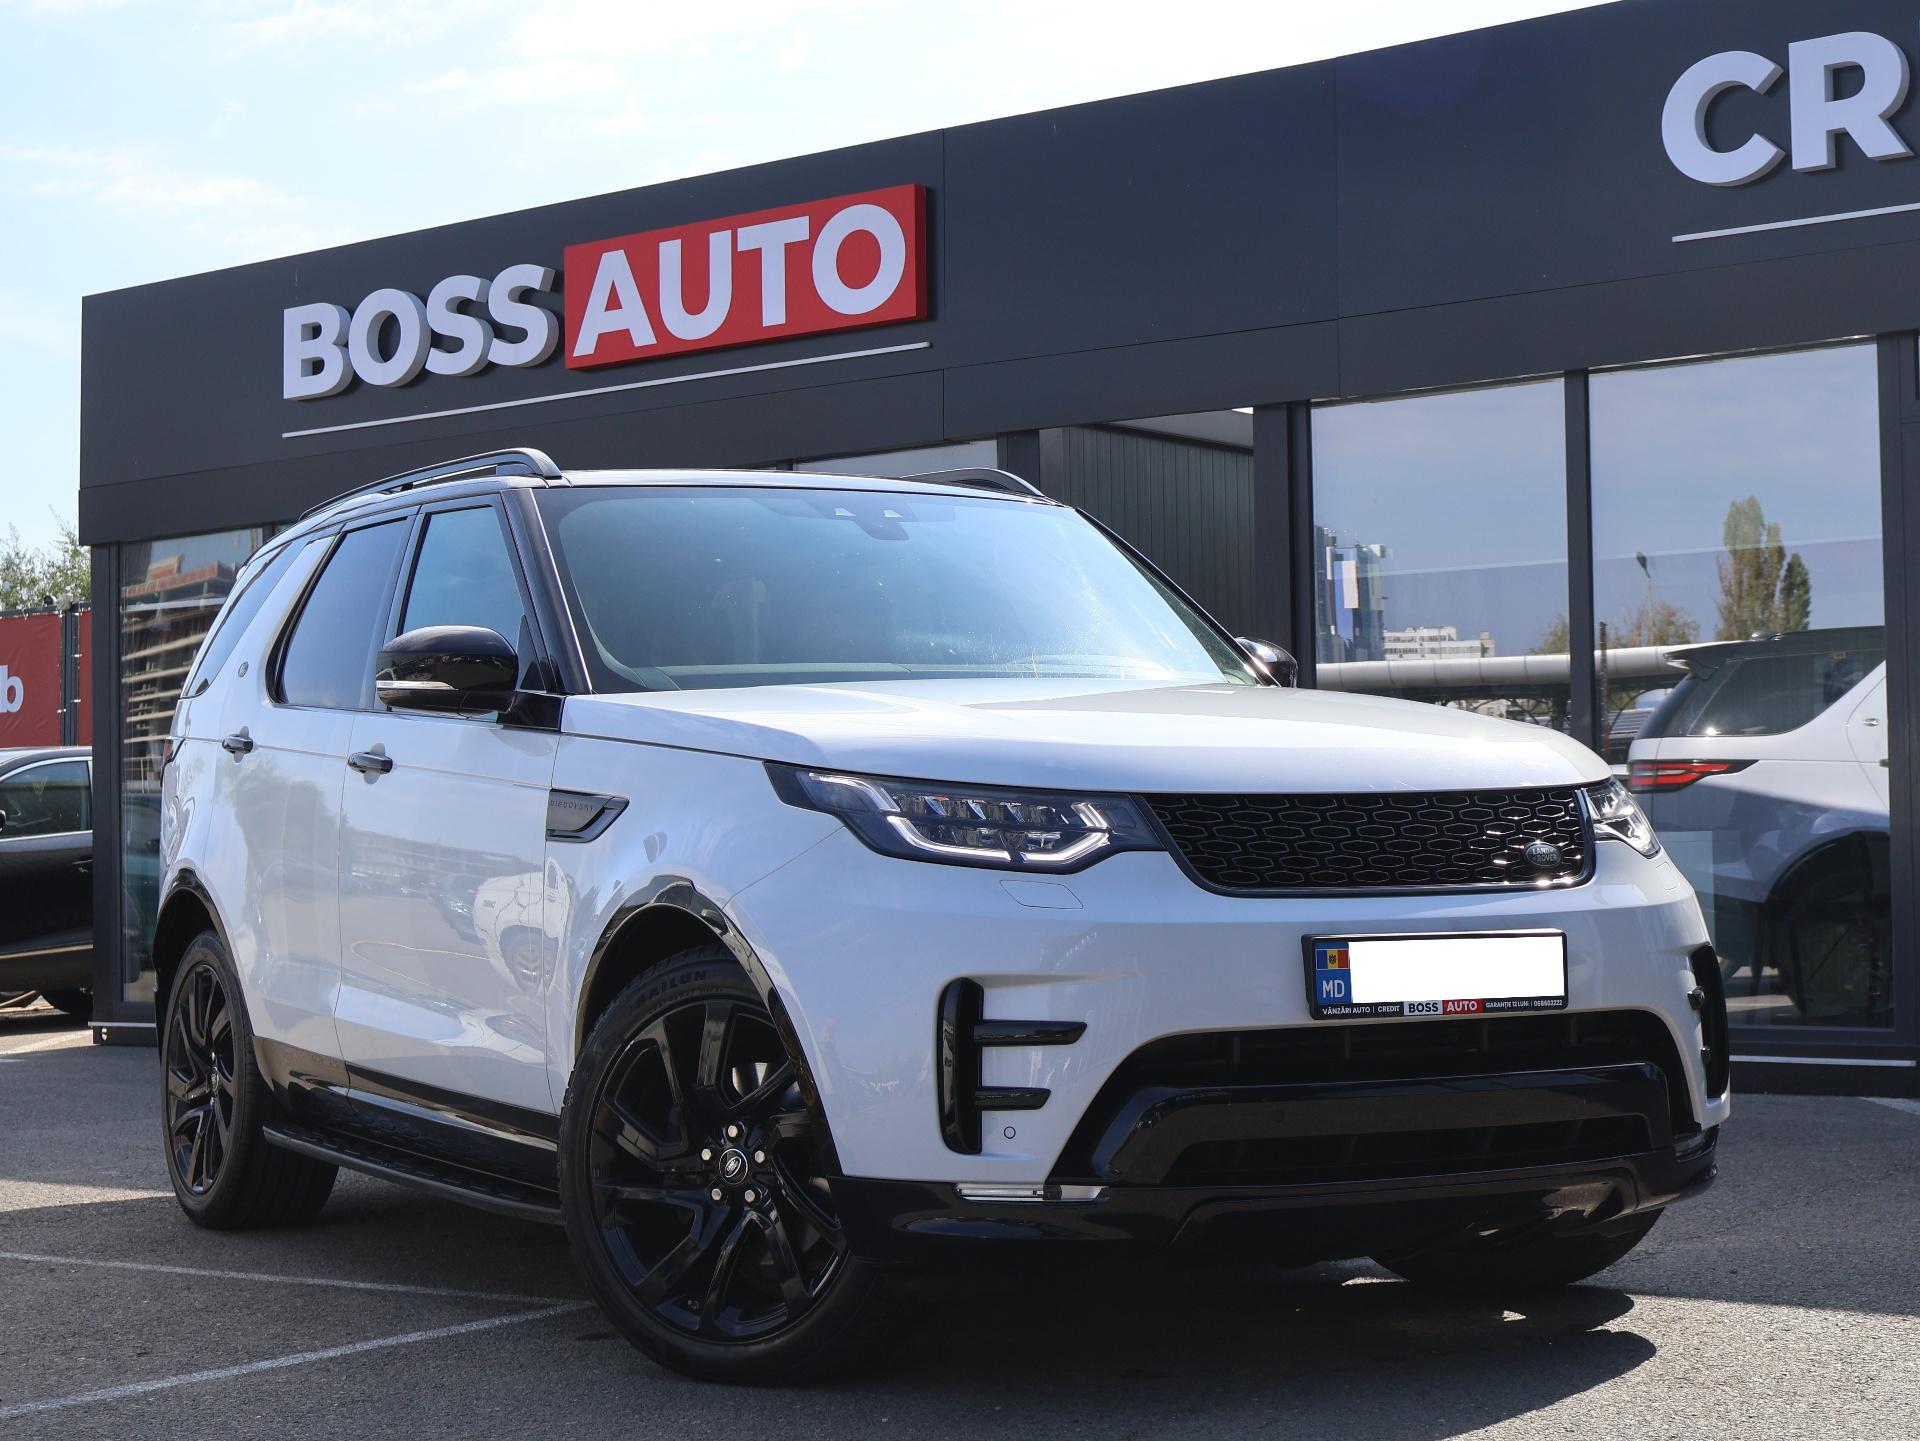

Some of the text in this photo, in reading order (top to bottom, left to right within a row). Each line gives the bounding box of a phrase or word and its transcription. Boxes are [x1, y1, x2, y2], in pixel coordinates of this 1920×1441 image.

[283, 203, 907, 400] BOSS AUTO
[1322, 980, 1345, 998] MD
[1352, 1006, 1371, 1014] AUTO
[1377, 1005, 1400, 1013] CREDIT
[1408, 1000, 1478, 1013] BOSS AUTO
